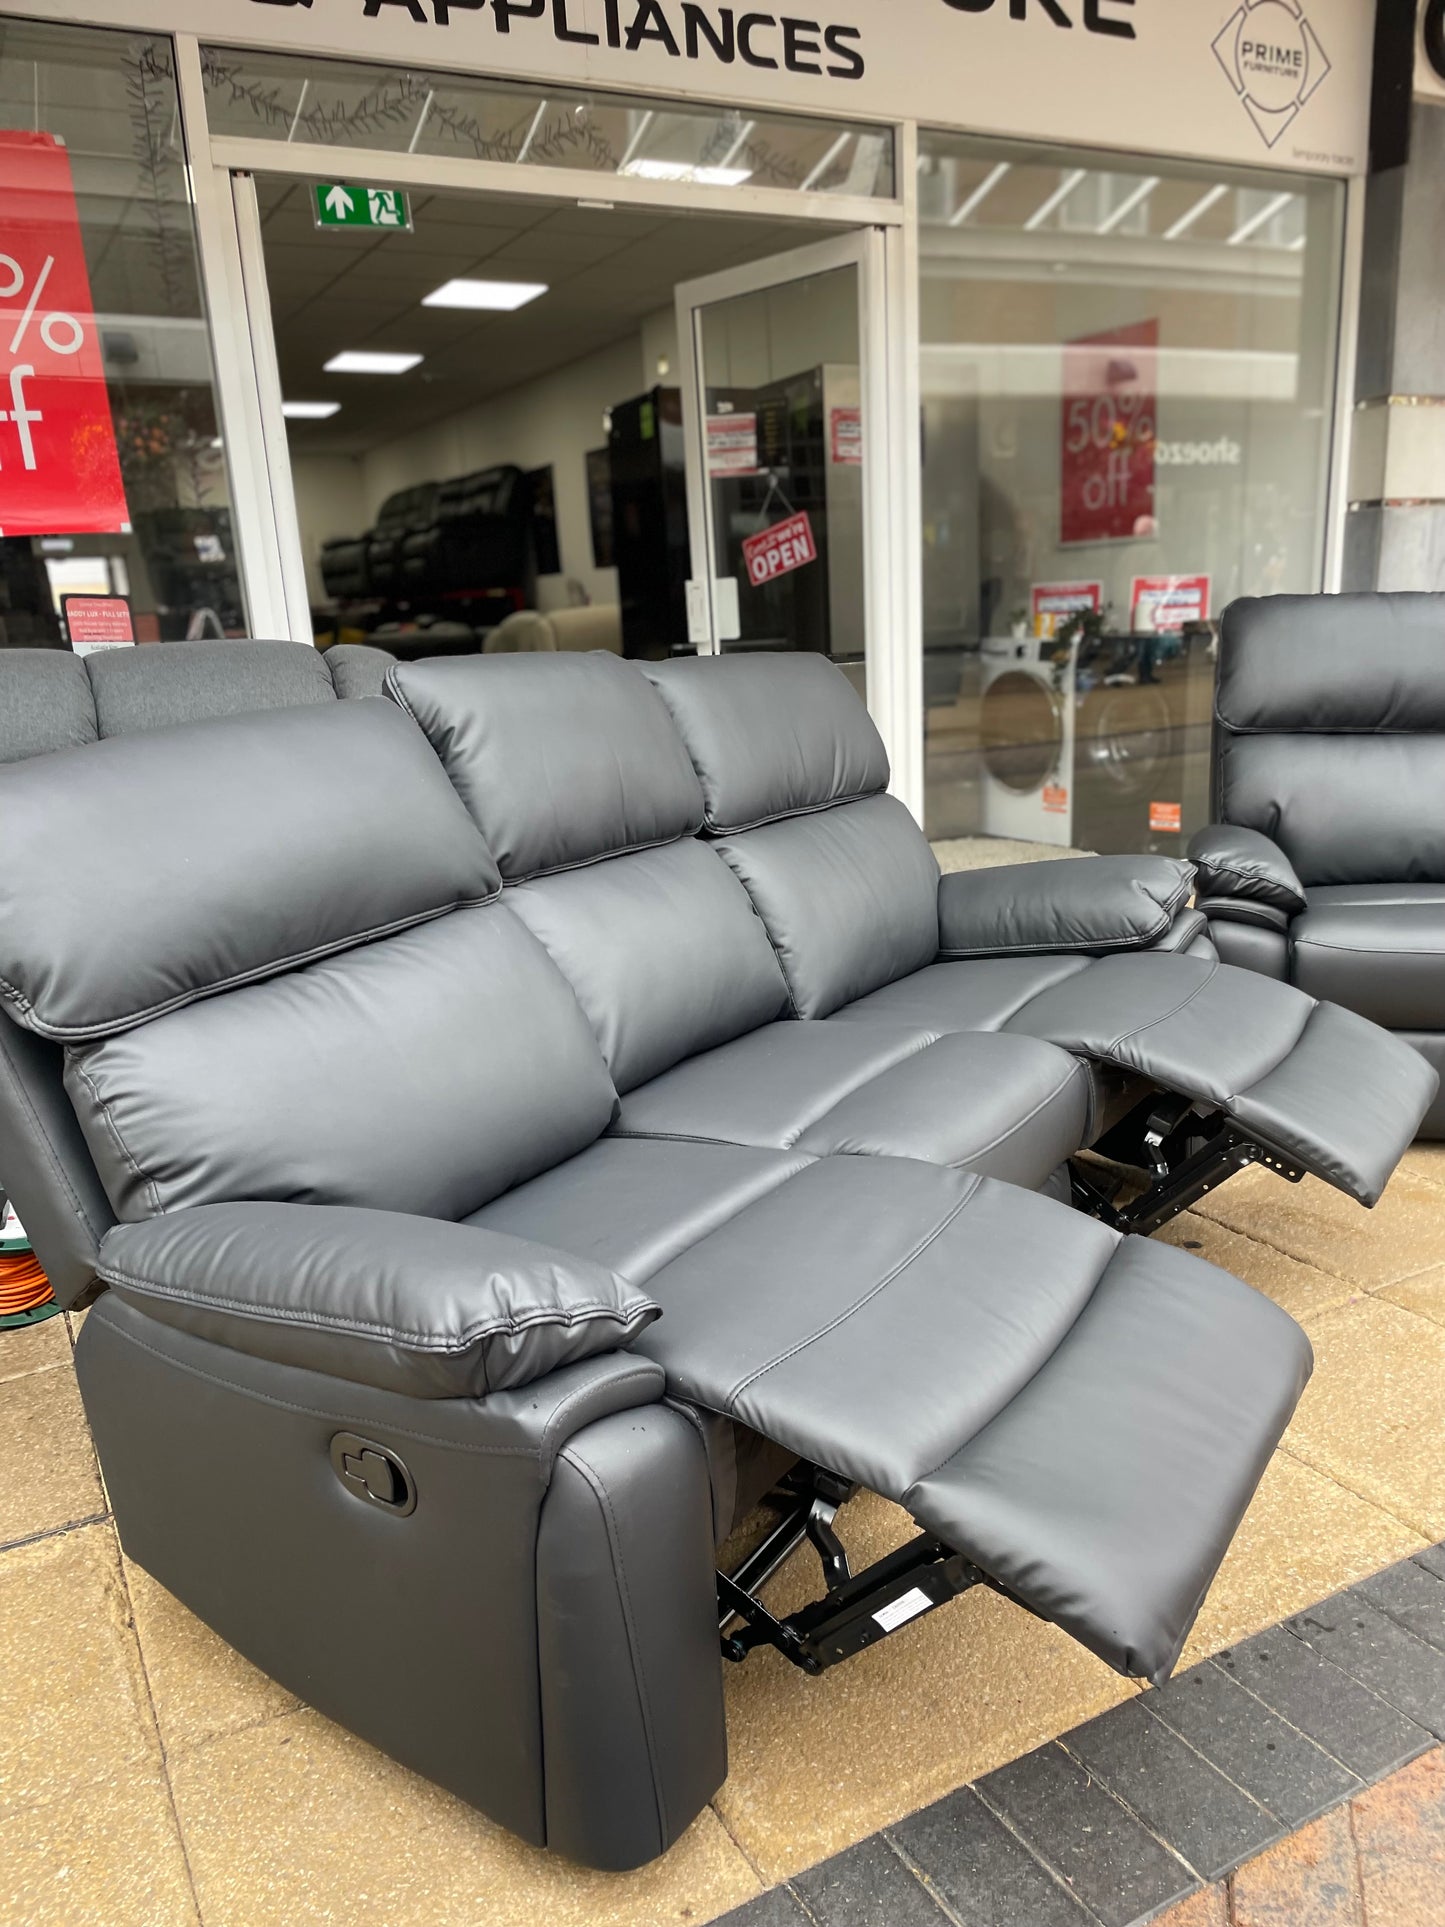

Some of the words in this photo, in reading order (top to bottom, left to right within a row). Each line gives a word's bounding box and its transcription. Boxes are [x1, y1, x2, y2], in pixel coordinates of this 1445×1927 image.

[1242, 41, 1302, 68] PRIME
[1243, 60, 1299, 79] FURNITURE
[0, 364, 43, 471] f
[1066, 386, 1154, 454] 50%
[1082, 448, 1132, 511] off
[752, 534, 810, 579] OPEN
